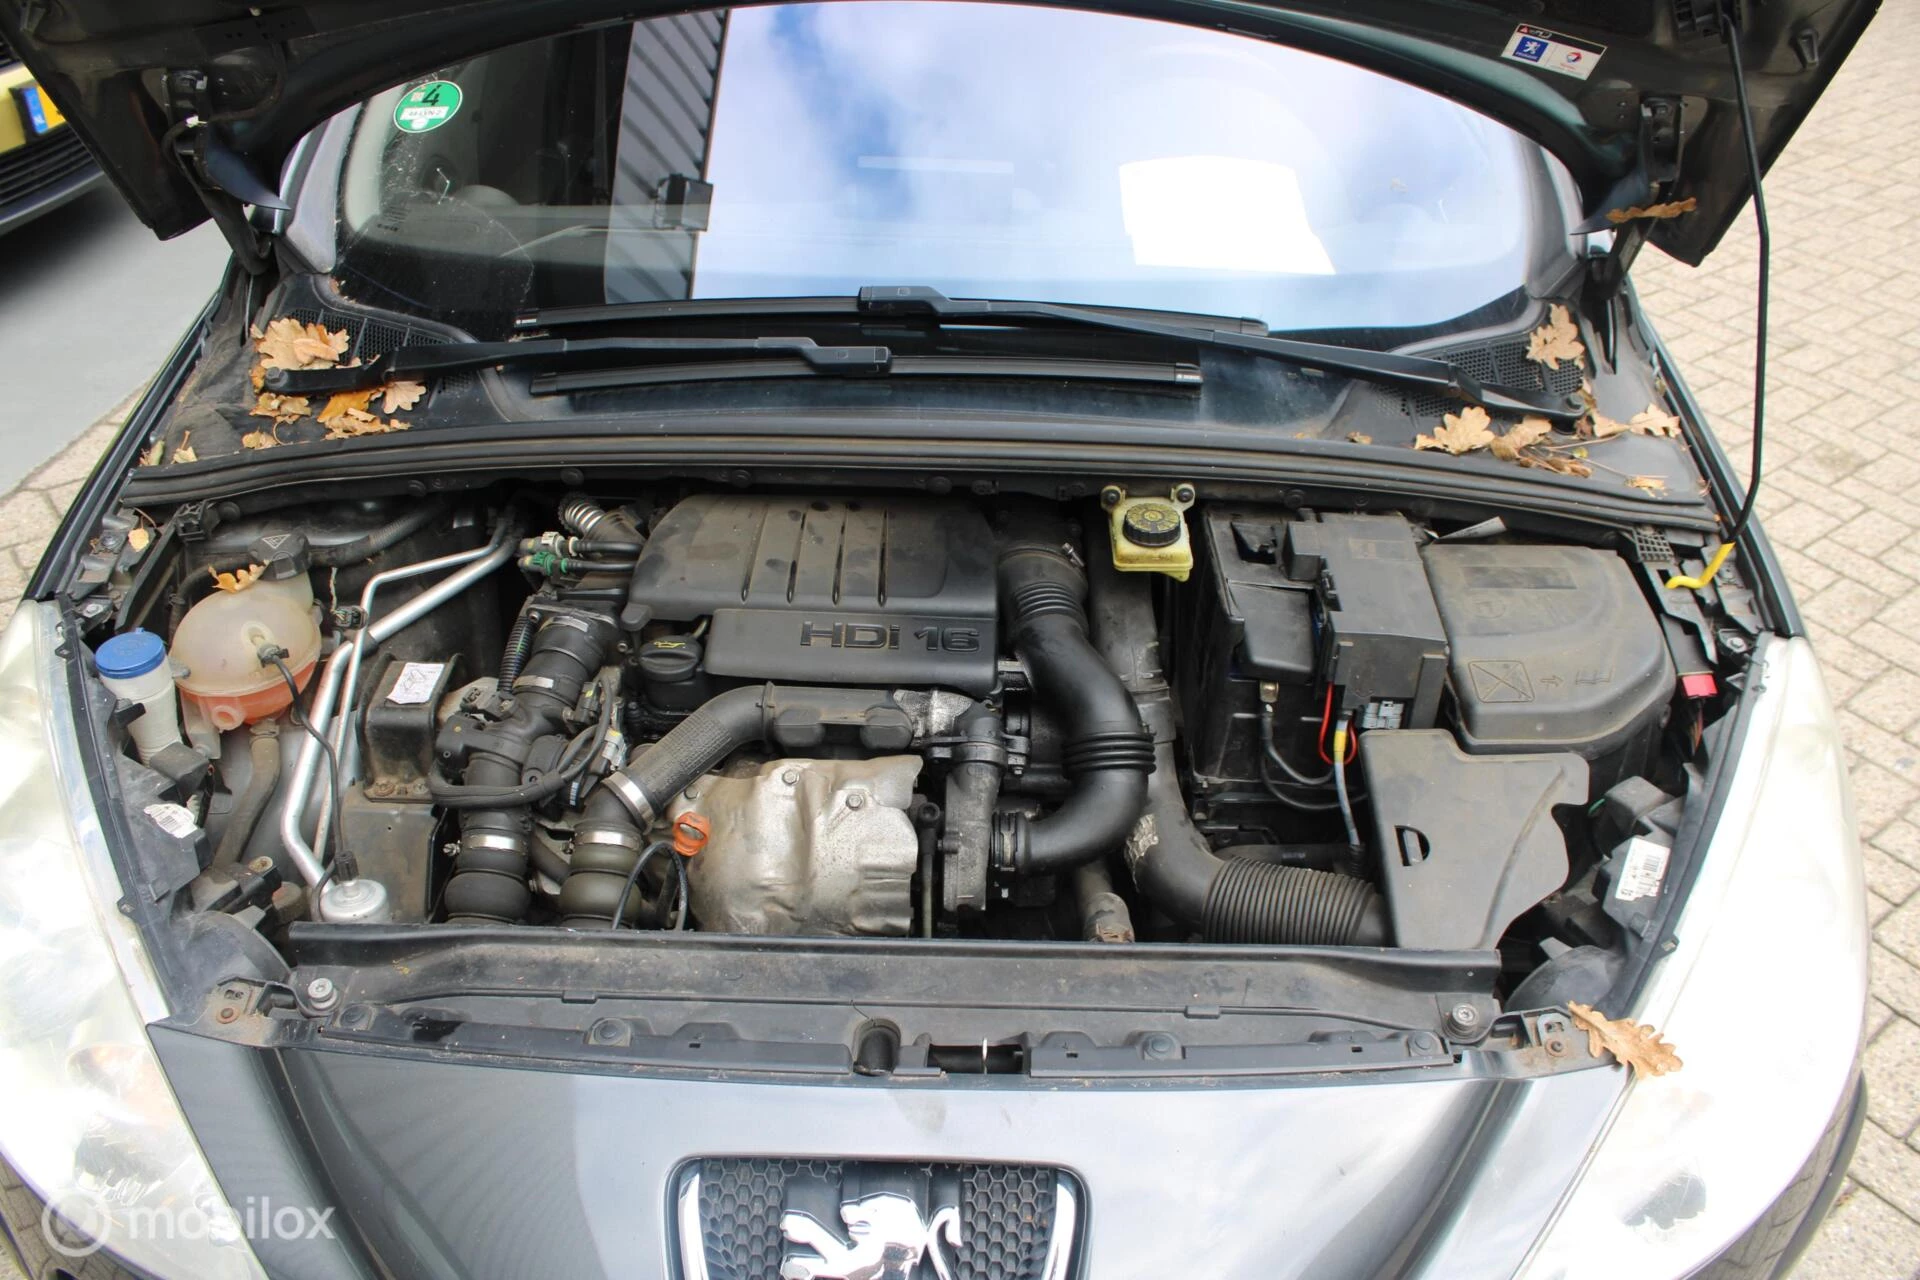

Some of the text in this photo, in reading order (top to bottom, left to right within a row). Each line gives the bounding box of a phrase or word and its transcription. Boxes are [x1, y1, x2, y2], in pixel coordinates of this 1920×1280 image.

[421, 84, 441, 106] 4
[800, 620, 980, 652] HDi 16
